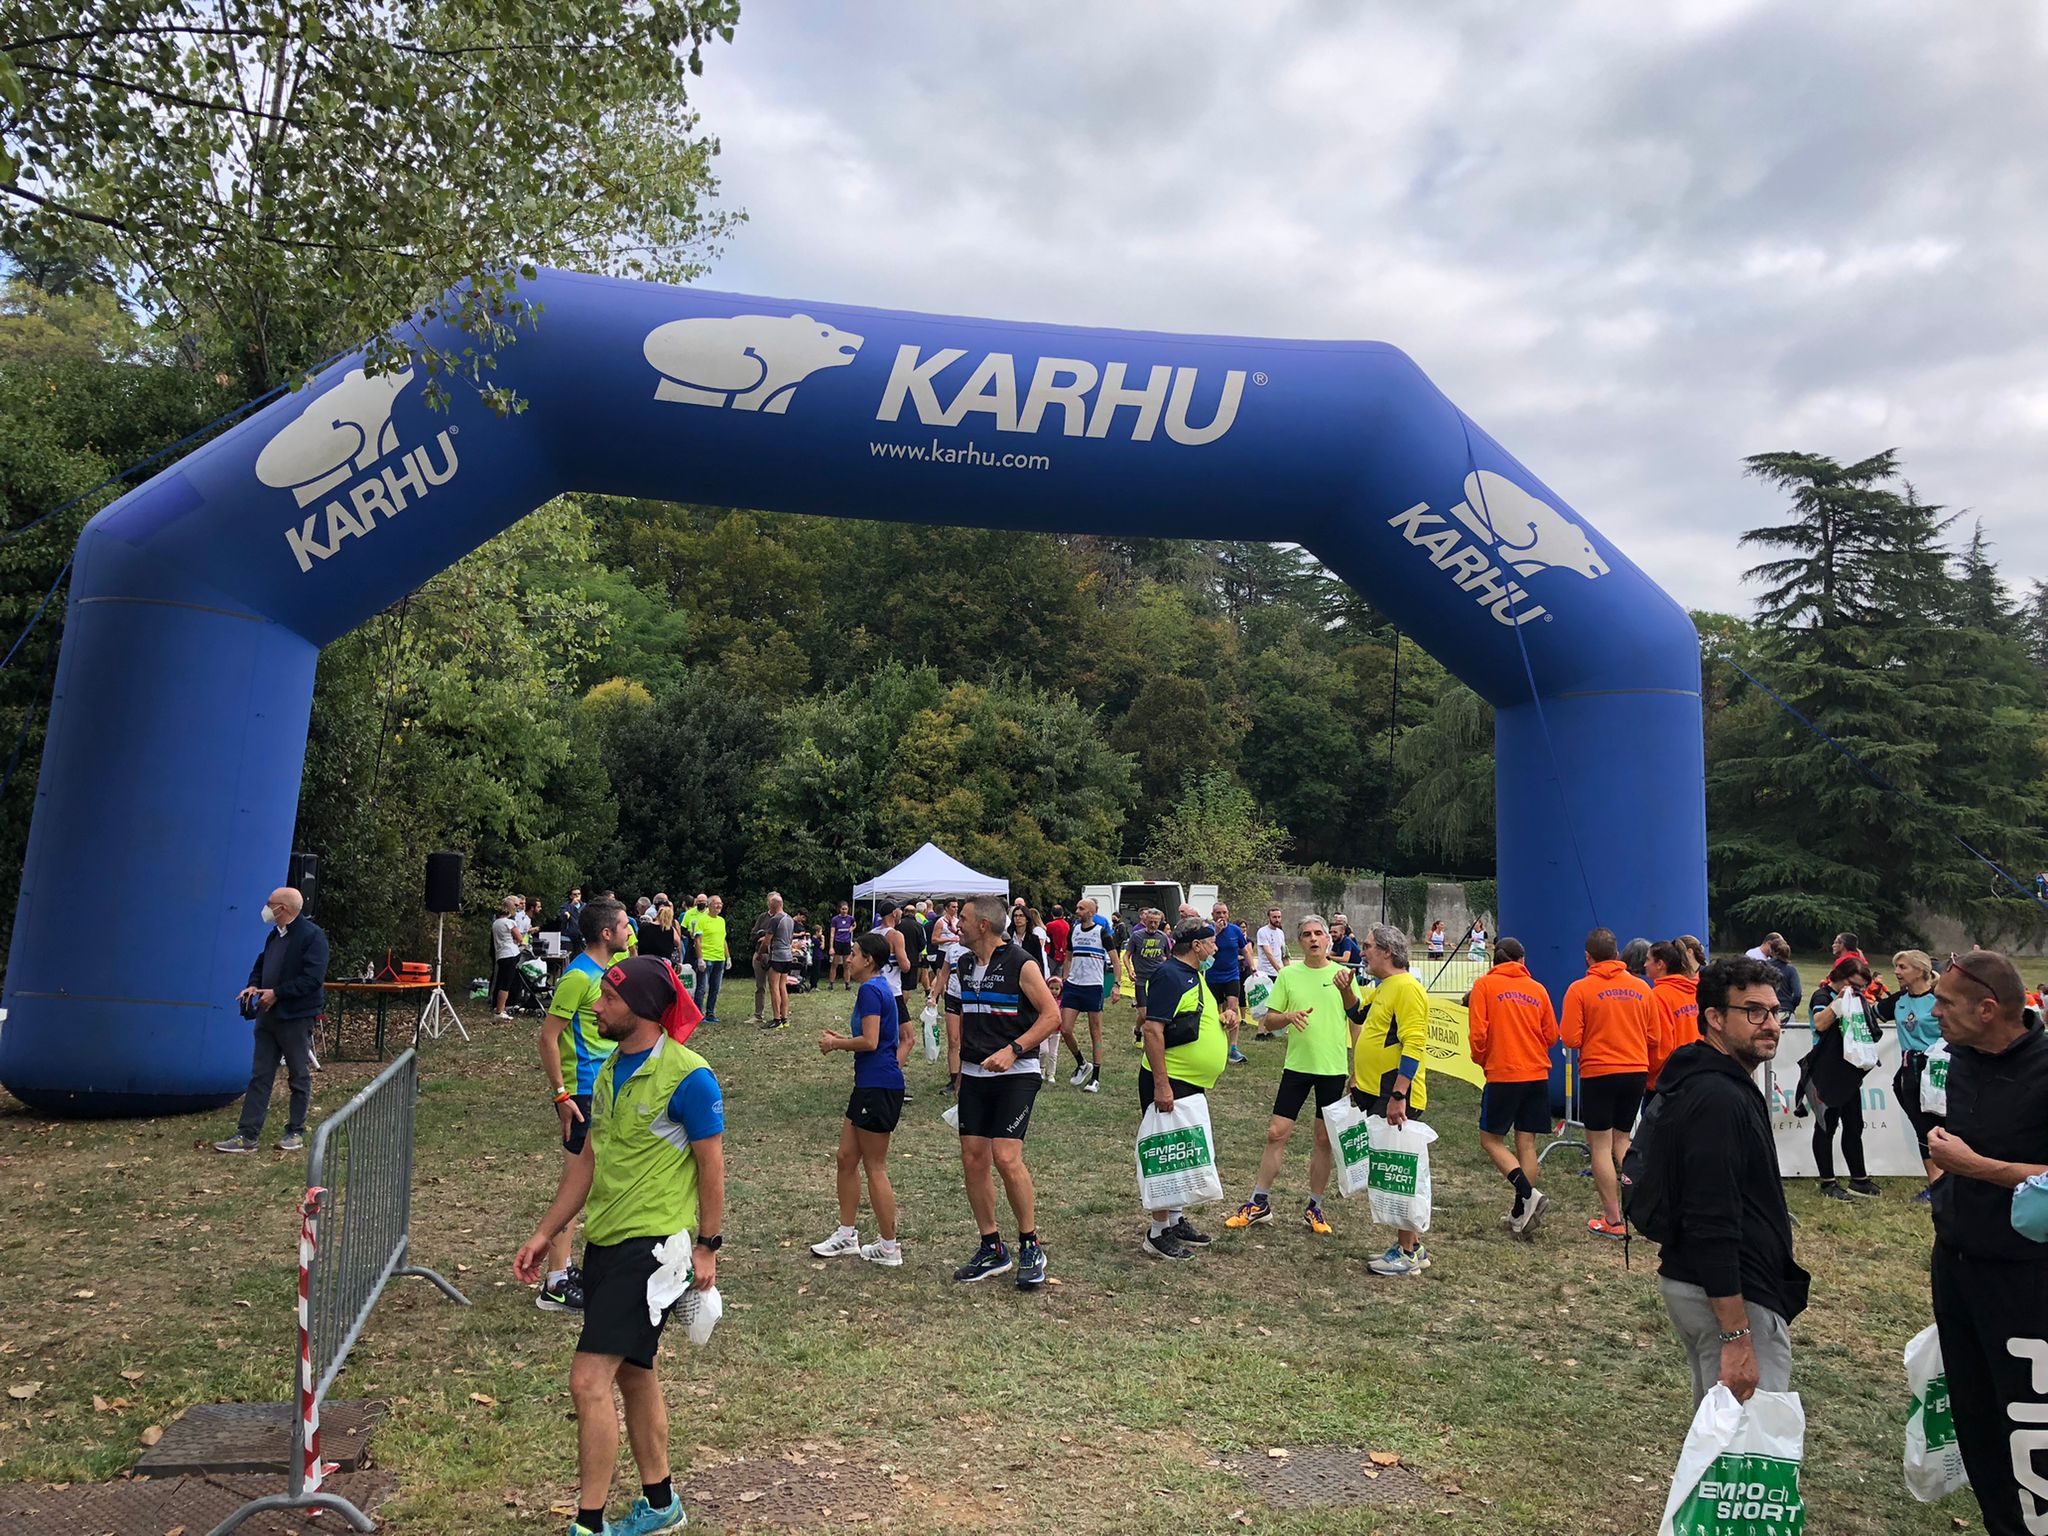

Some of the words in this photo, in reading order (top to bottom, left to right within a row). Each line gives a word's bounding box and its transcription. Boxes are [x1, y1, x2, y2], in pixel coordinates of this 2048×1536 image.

[875, 344, 1247, 446] KARHU
[869, 439, 1050, 470] www.karhu.com
[284, 429, 460, 573] KARHU
[1387, 501, 1547, 626] KARHU
[1427, 1025, 1460, 1046] AMBARO
[1142, 1142, 1186, 1159] TEMPO
[1158, 1146, 1204, 1164] SPORT
[1698, 1481, 1766, 1500] EMPO
[1767, 1485, 1789, 1503] di
[1716, 1501, 1801, 1523] SPORT
